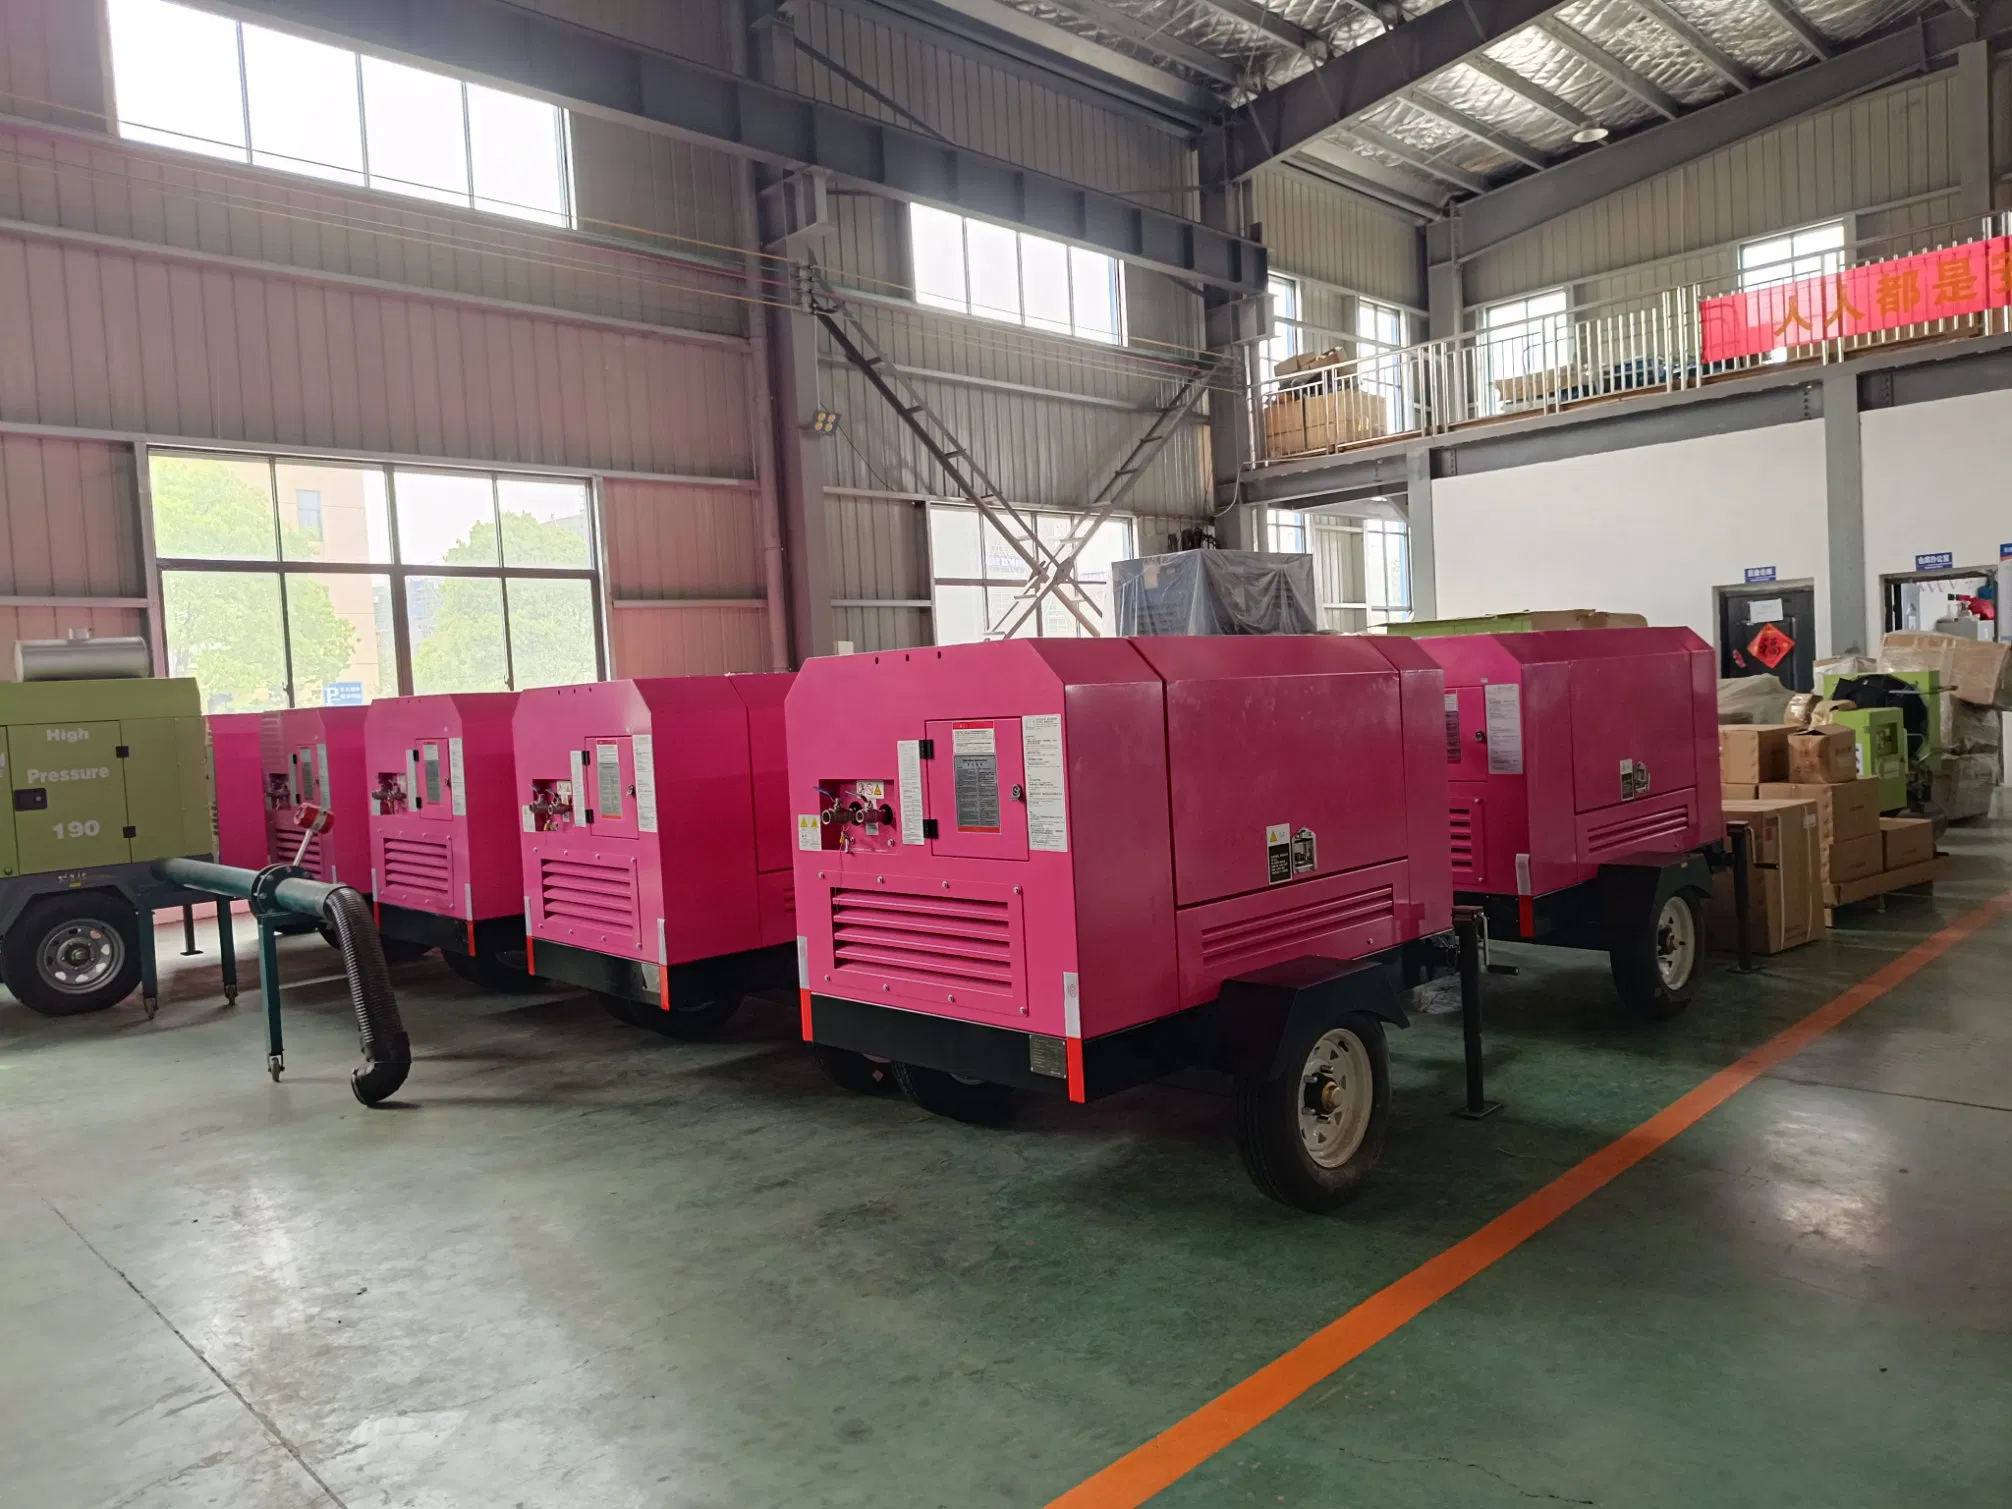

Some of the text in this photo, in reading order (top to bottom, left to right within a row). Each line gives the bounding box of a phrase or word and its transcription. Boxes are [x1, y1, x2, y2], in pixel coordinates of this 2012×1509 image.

[325, 687, 340, 705] P
[46, 728, 89, 742] High
[27, 766, 109, 784] Pressure
[52, 819, 101, 840] 190
